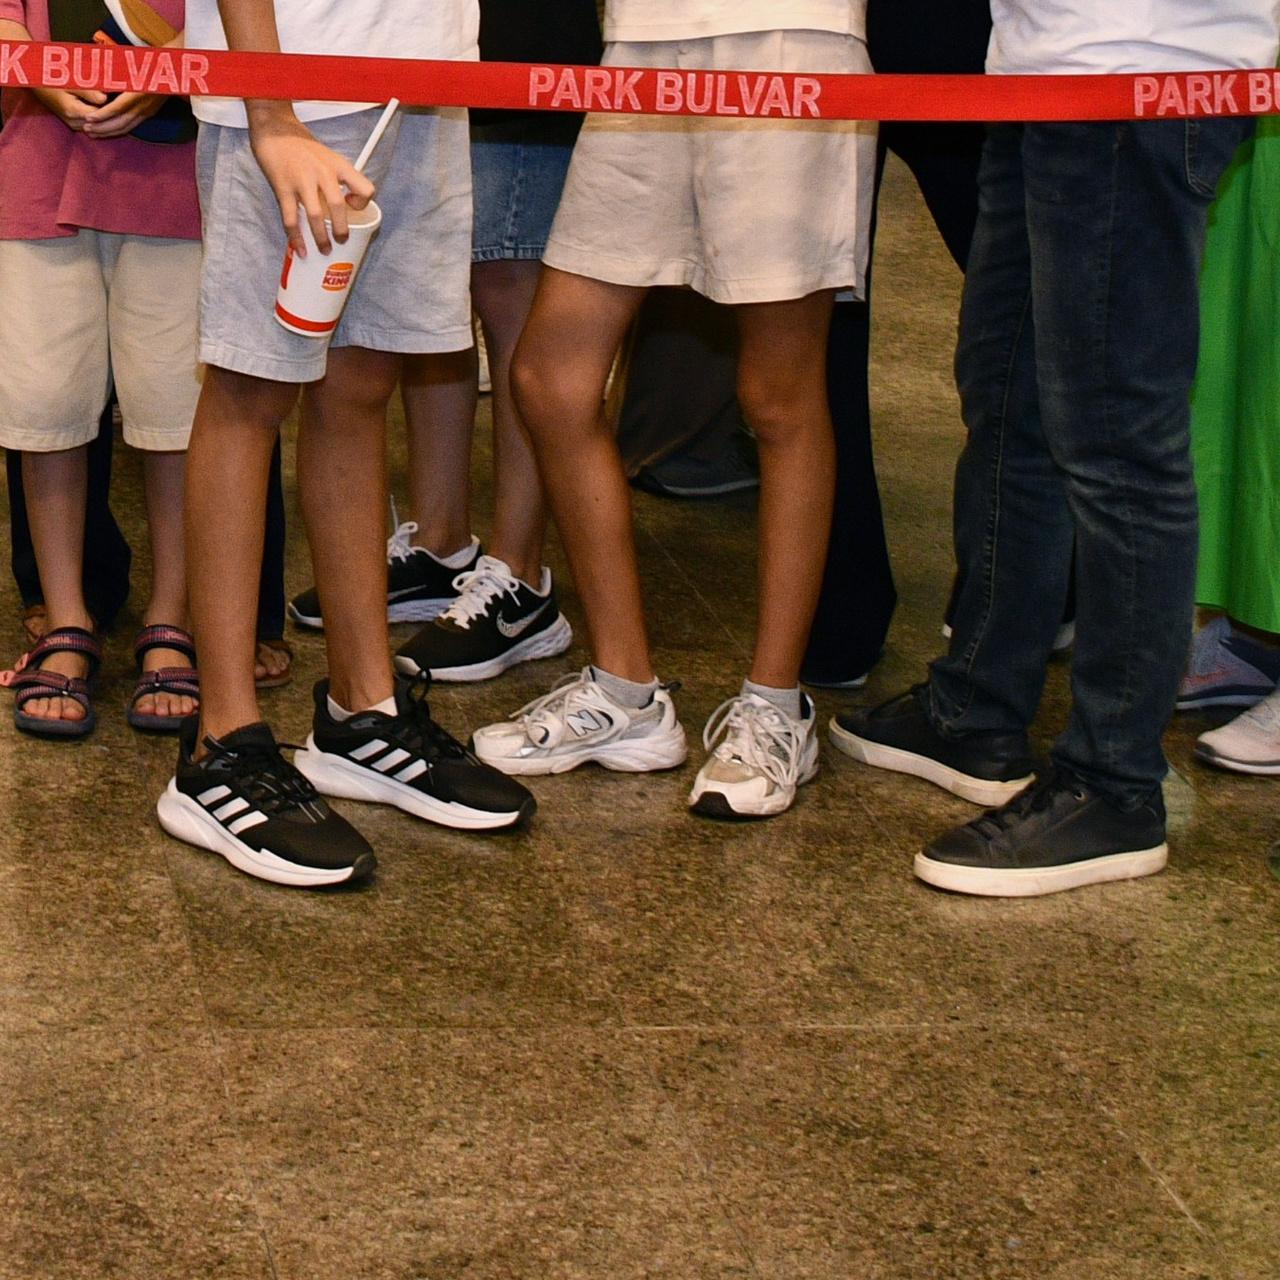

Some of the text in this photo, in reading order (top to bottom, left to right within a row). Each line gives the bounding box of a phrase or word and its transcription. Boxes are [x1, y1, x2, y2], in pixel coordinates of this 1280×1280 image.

[42, 45, 209, 94] BULVAR
[528, 66, 822, 117] PARK BULVAR
[1133, 73, 1239, 117] PARK
